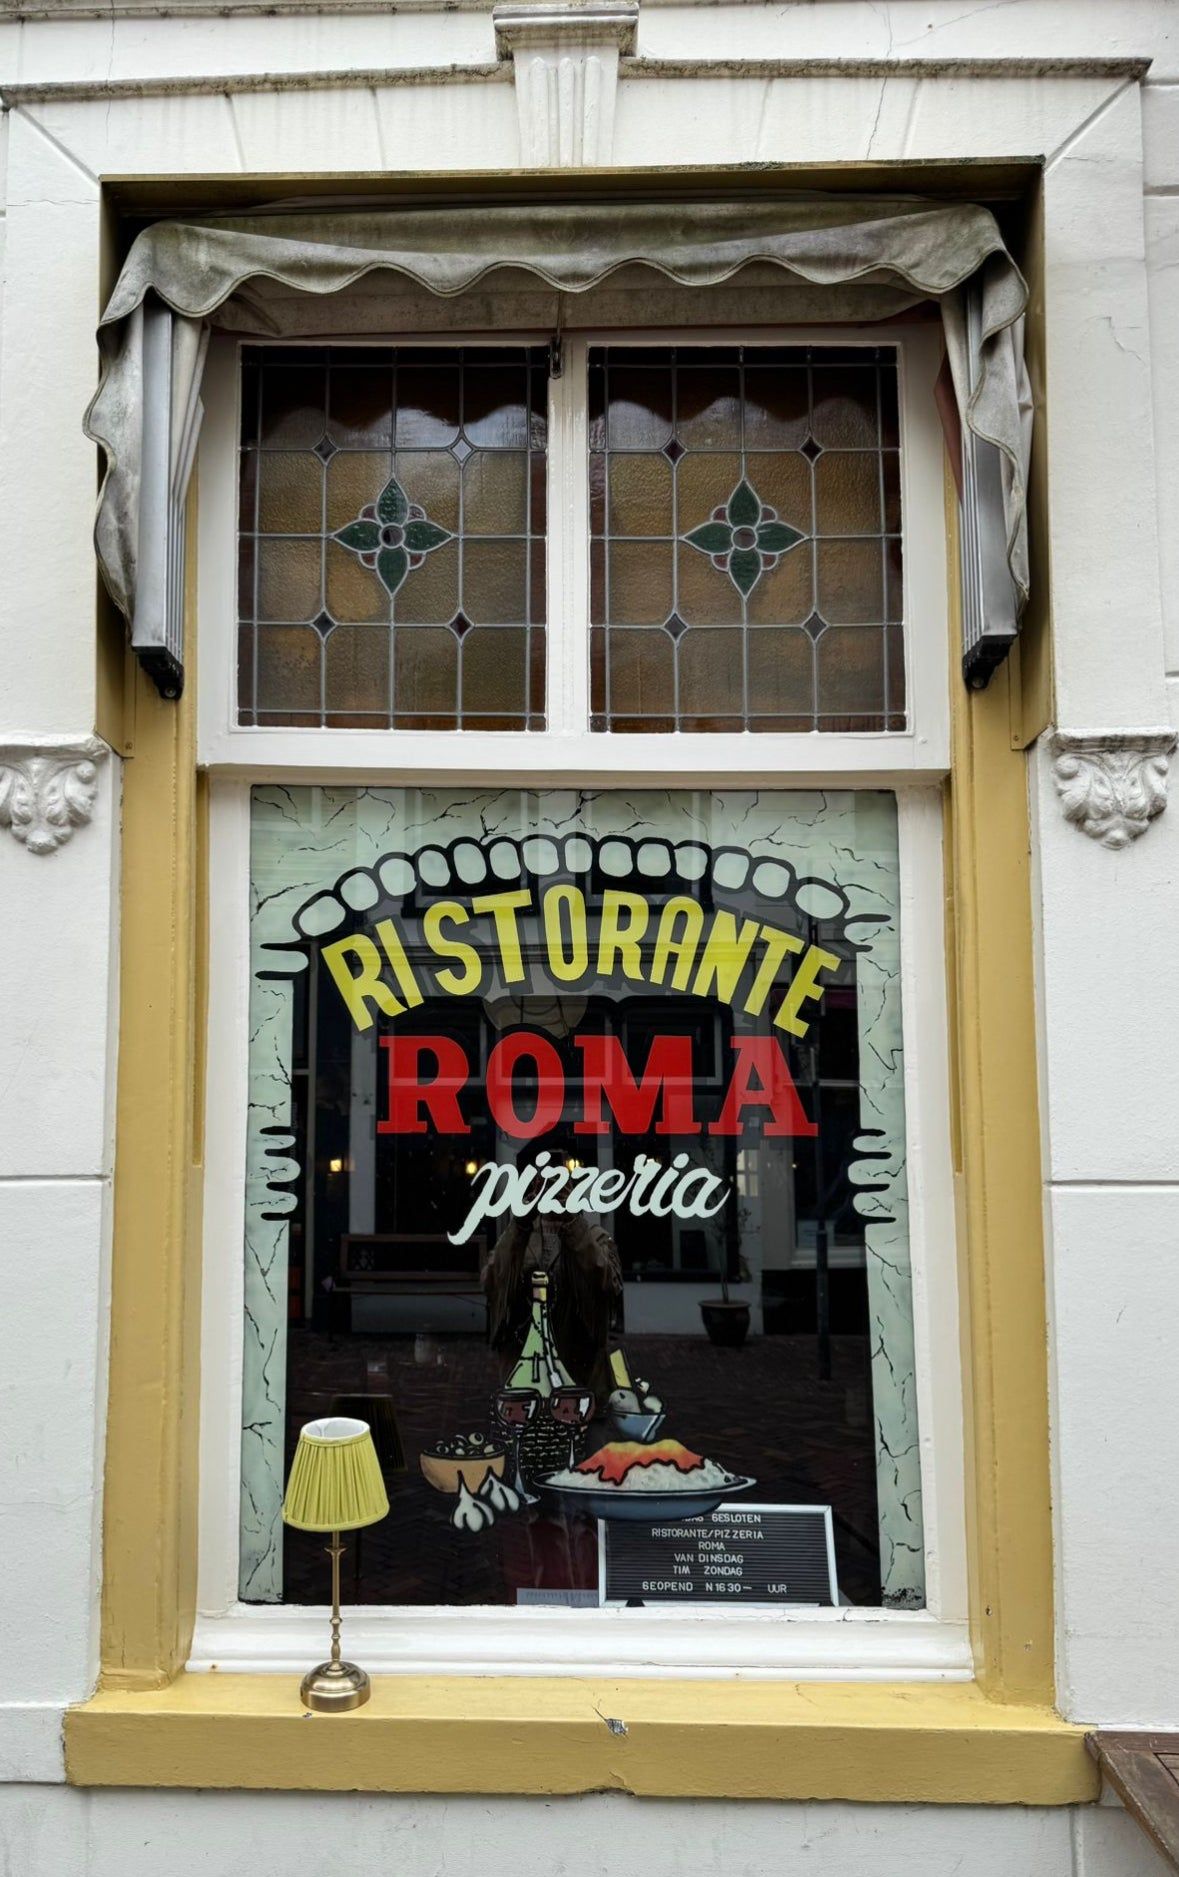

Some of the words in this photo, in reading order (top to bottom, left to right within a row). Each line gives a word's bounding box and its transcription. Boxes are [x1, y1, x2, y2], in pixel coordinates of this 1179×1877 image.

[321, 885, 842, 1039] RISTORANTE
[377, 1031, 819, 1139] ROMA
[447, 1151, 730, 1246] pizzeria
[698, 1541, 726, 1551] ROMA
[673, 1553, 694, 1563] VAN
[698, 1553, 744, 1564] DINSDAG
[703, 1565, 743, 1576] ZONDAG
[767, 1584, 788, 1594] UUR
